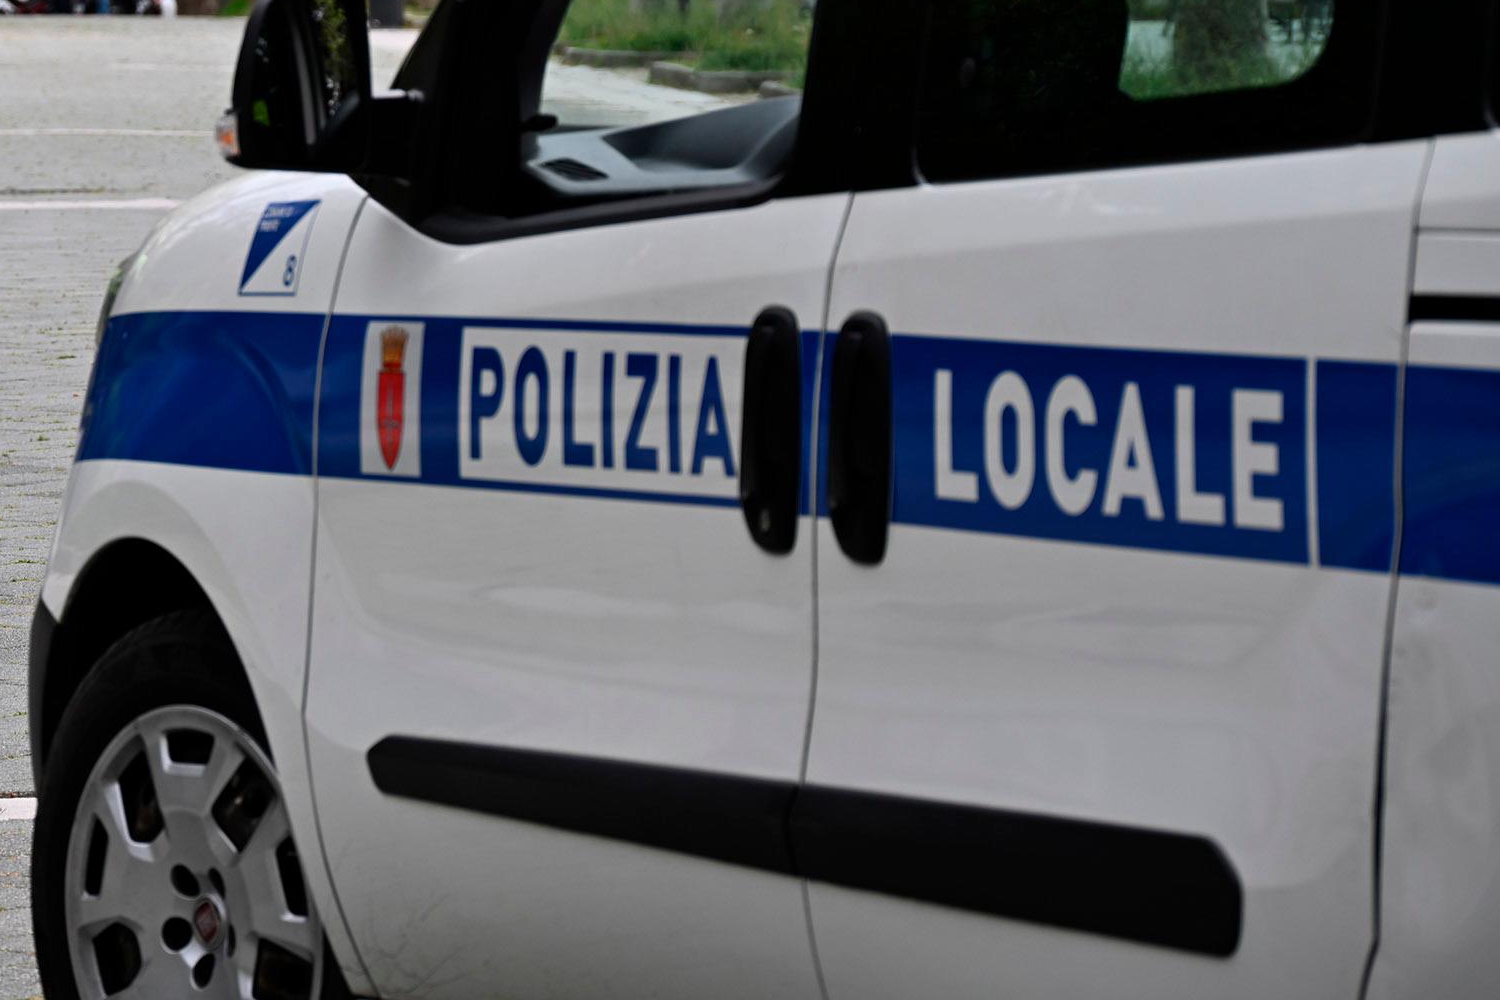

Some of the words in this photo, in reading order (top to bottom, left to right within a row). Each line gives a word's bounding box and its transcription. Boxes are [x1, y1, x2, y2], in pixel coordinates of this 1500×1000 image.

[283, 254, 297, 287] 8
[469, 346, 738, 478] POLIZIA
[934, 369, 1284, 532] LOCALE
